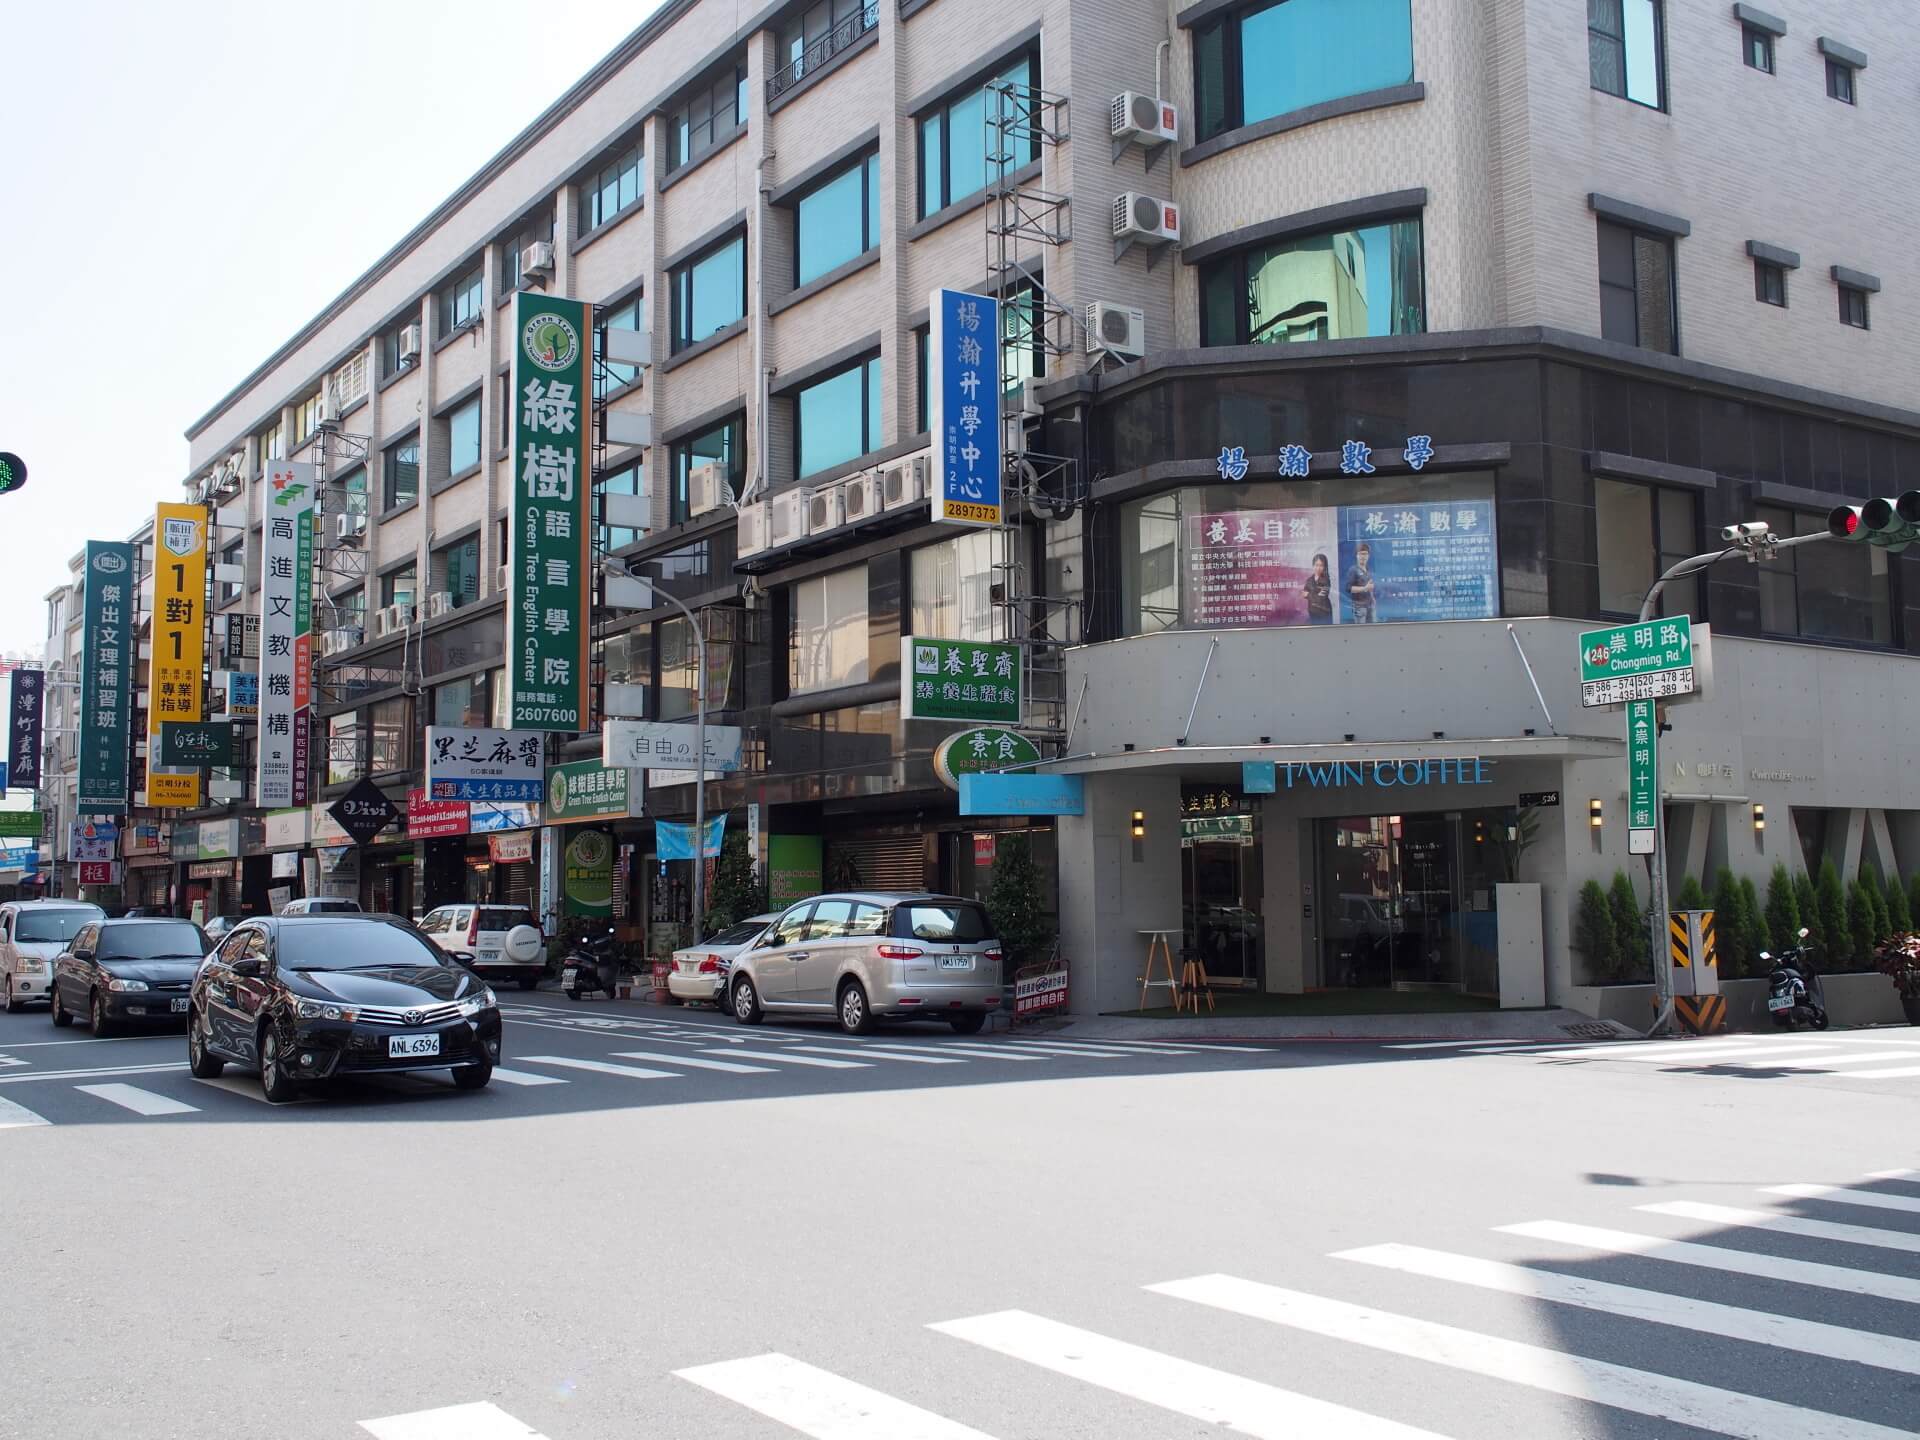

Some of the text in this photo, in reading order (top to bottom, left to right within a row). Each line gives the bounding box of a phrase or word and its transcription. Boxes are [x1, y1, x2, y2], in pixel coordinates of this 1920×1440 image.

[956, 301, 982, 499] 楊瀚升學中心
[1216, 435, 1435, 480] 楊瀚數學
[948, 503, 996, 520] 2897373
[1365, 510, 1478, 536] 楊瀚數學
[523, 506, 540, 684] Green Tree English Center
[166, 564, 193, 660] 1對1
[231, 616, 241, 656] 米加設計
[267, 517, 293, 736] 高進文教機構
[1610, 624, 1680, 653] 崇明路
[97, 585, 121, 728] 傑出文理補習班
[1591, 646, 1609, 662] 246
[1611, 650, 1681, 671] Chongming Rd.
[1679, 669, 1692, 683] 北
[161, 683, 192, 697] 專業
[1584, 684, 1595, 697] 南
[160, 698, 192, 713] 指導
[515, 707, 577, 722] 2607600
[1634, 703, 1647, 718] 西
[433, 736, 541, 768] 黑芝麻醬
[968, 732, 1018, 759] 素食
[568, 769, 626, 795] 綠樹語言學院
[1374, 759, 1493, 787] COFFEE
[1635, 730, 1649, 825] 崇明十三街
[1180, 790, 1232, 811] 生蔬食
[1541, 794, 1557, 804] 526
